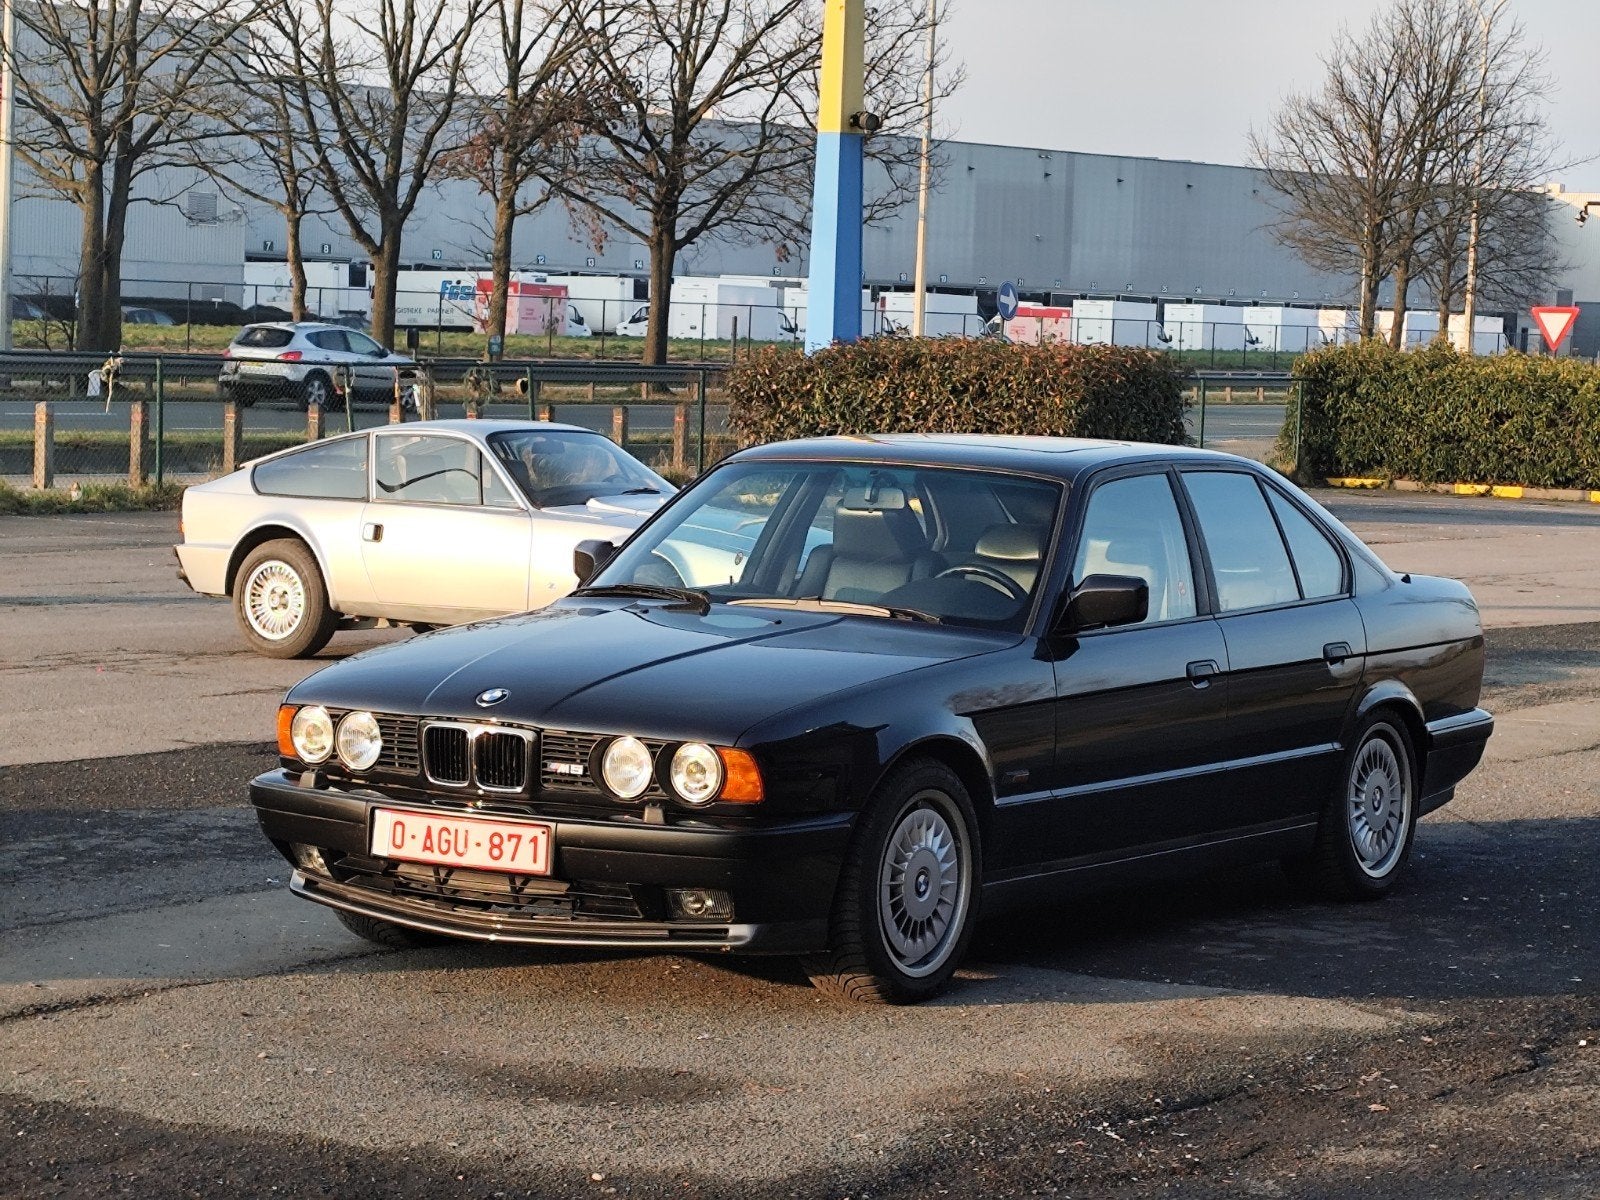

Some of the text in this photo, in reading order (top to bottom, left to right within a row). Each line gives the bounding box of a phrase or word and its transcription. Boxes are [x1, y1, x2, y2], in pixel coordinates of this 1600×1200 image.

[265, 241, 272, 251] 7
[323, 244, 329, 253] 8
[433, 250, 441, 259] 10
[537, 256, 545, 264] 12
[635, 260, 643, 269] 14
[774, 267, 781, 275] 15
